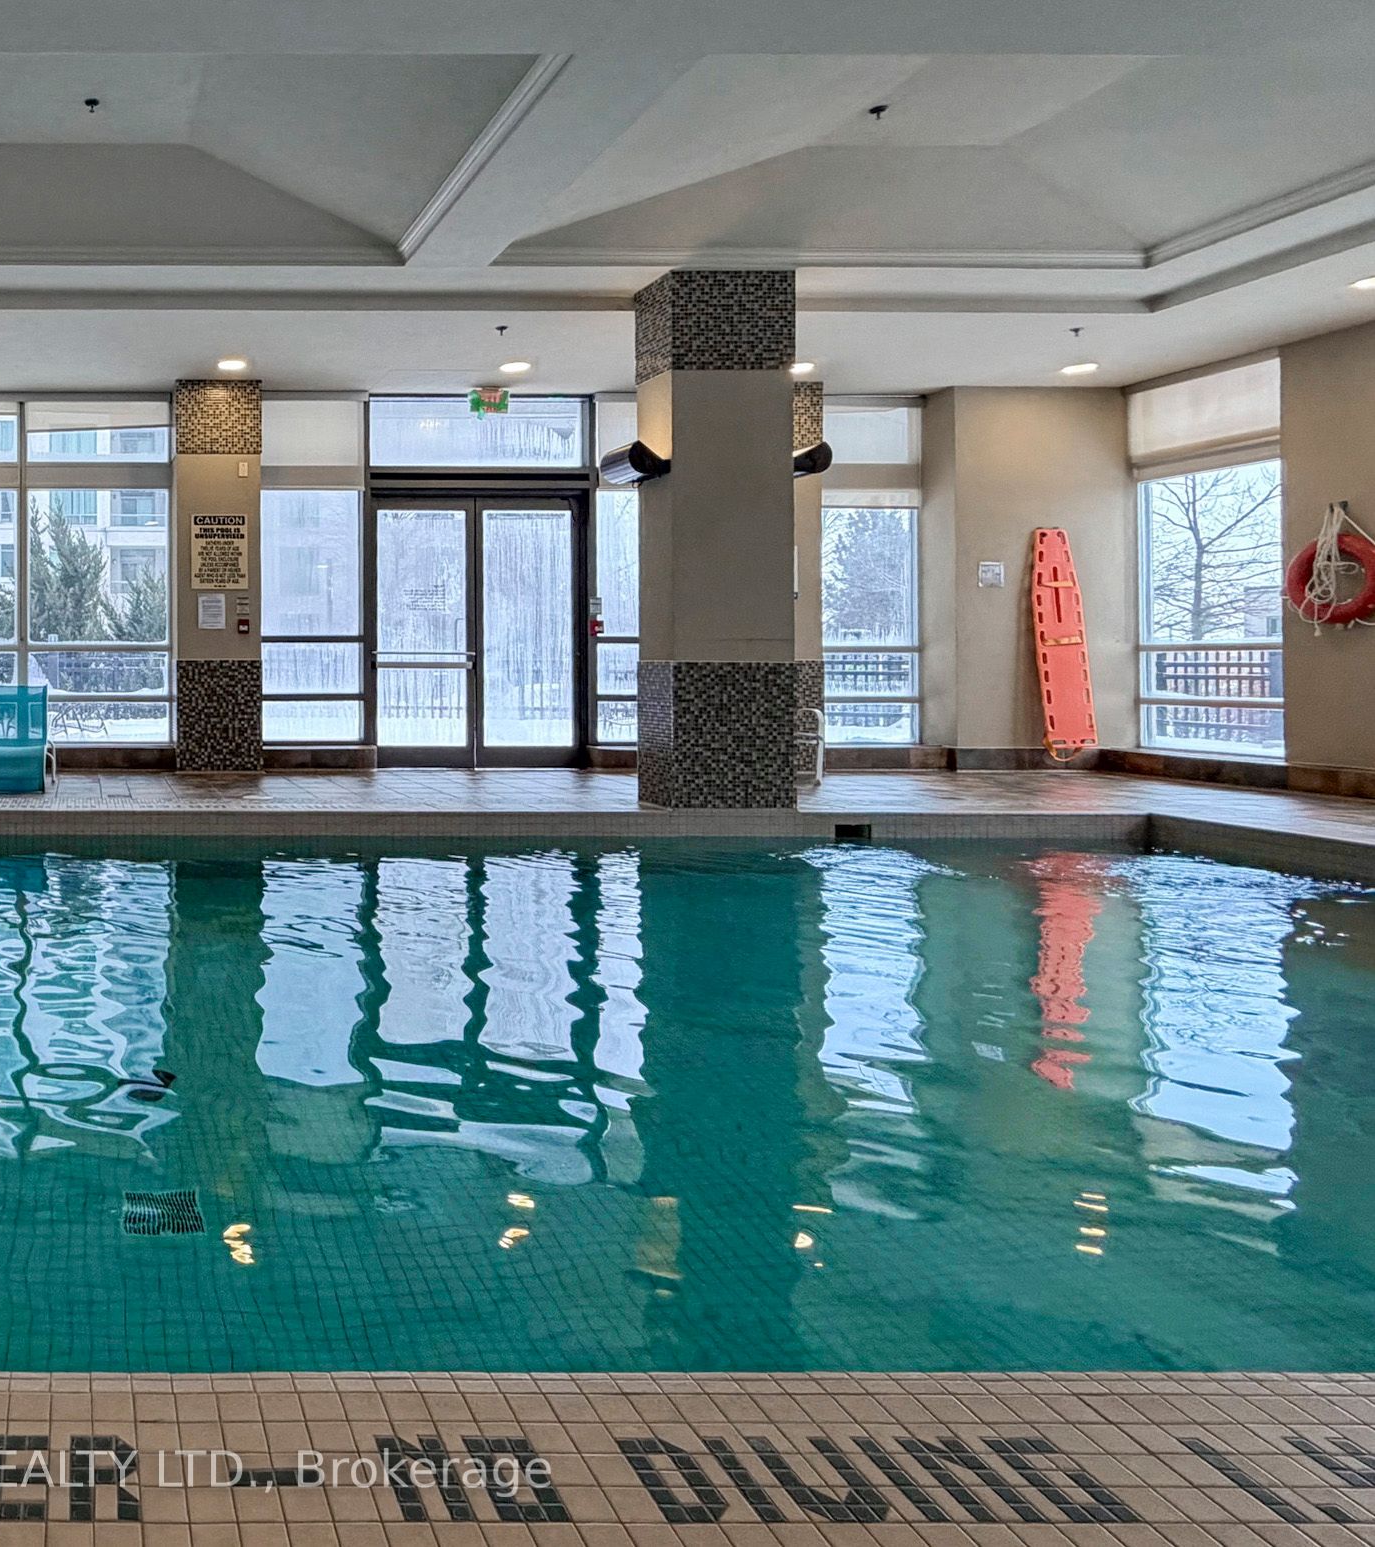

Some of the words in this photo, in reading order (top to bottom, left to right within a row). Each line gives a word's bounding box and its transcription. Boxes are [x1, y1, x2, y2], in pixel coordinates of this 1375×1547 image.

[196, 517, 243, 525] CAUTION
[373, 1434, 572, 1522] NO
[615, 1436, 1144, 1523] DIVING
